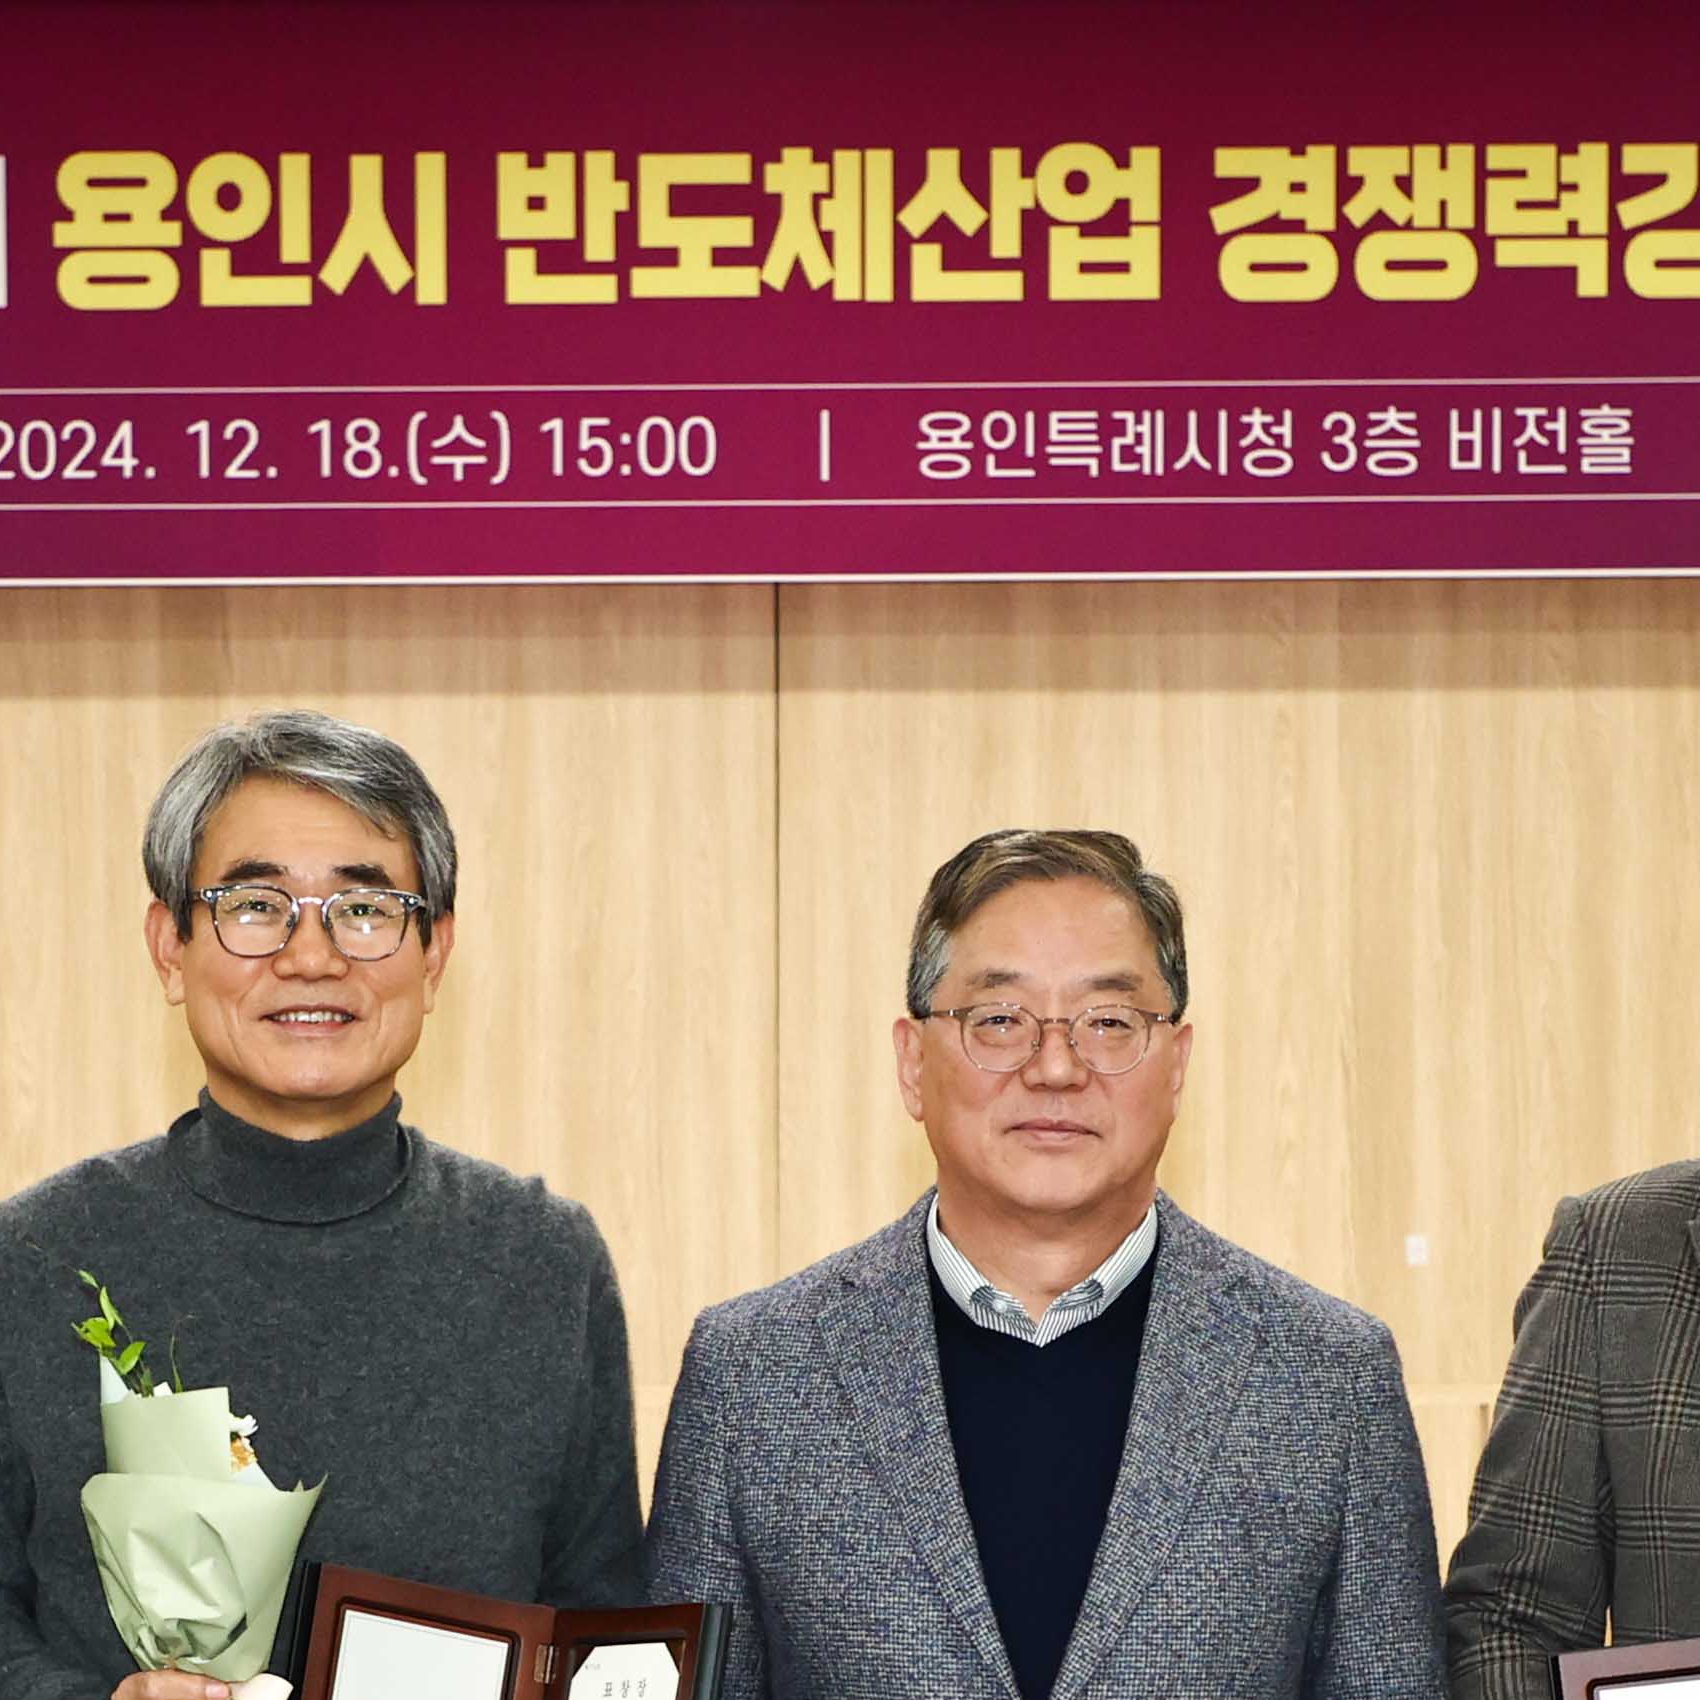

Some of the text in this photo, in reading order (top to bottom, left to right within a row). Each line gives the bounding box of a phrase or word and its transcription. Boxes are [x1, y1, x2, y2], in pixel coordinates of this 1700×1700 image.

[53, 151, 447, 311] 용인시
[497, 143, 1161, 305] 반도체산업
[187, 419, 278, 479] 12.
[308, 410, 511, 485] 18.(수)
[540, 415, 717, 477] 15:00
[916, 407, 1294, 480] 용인특례시청
[1321, 405, 1421, 476] 3층
[1449, 404, 1634, 474] 비전홀
